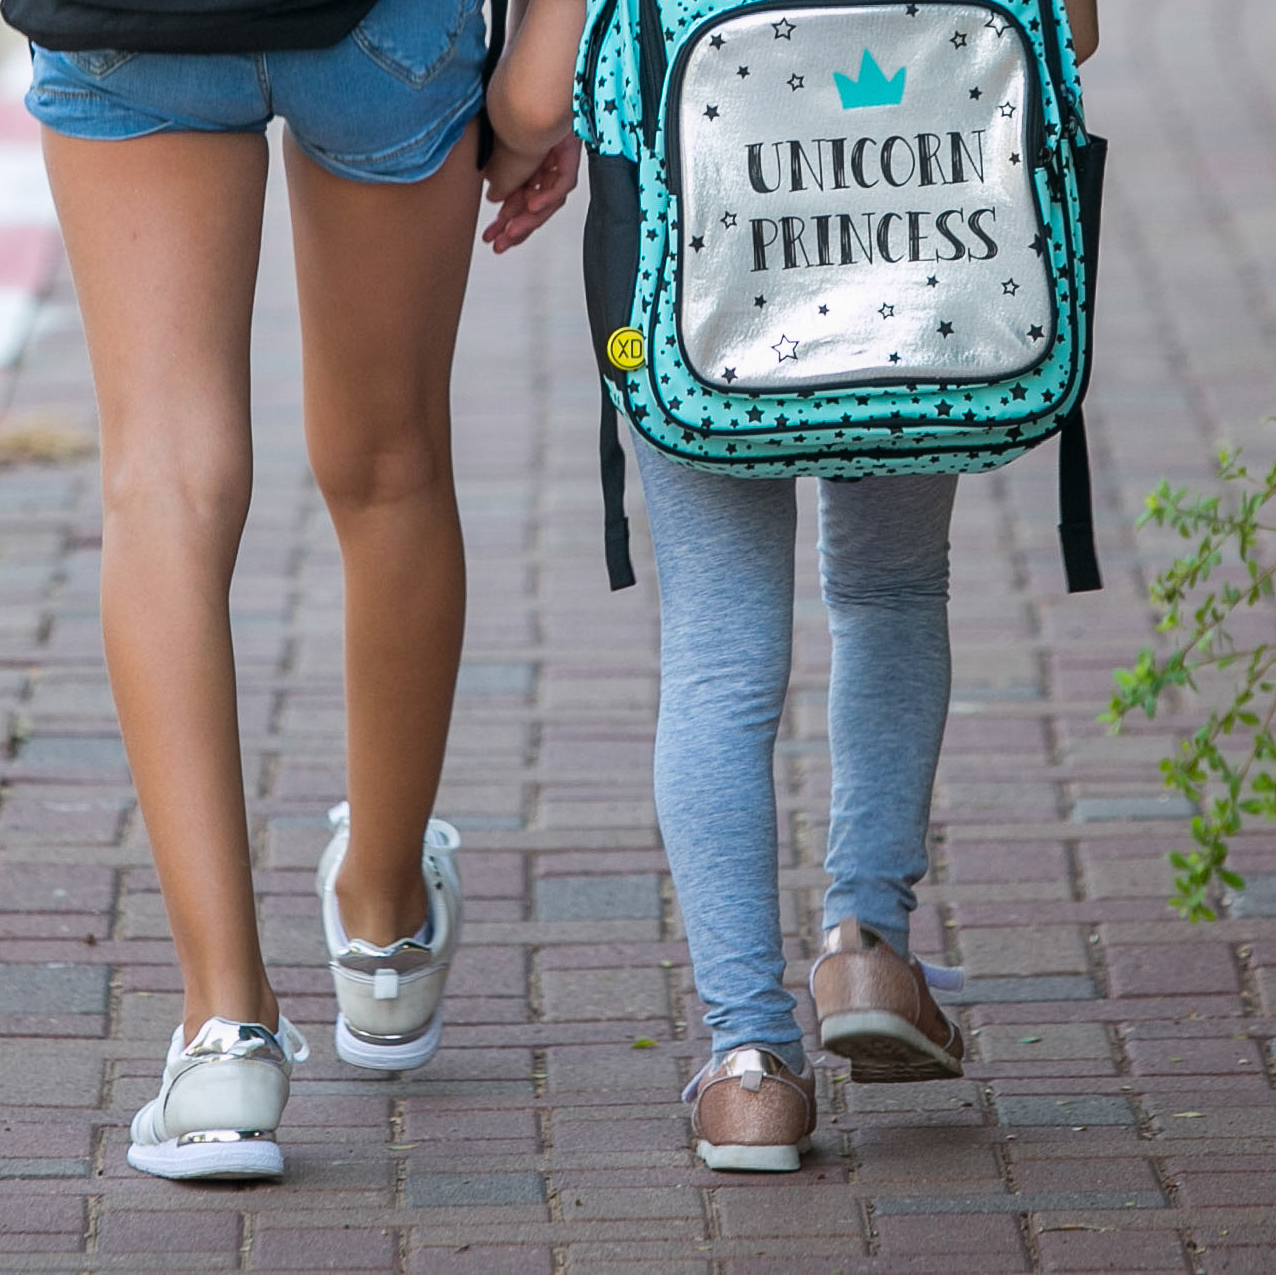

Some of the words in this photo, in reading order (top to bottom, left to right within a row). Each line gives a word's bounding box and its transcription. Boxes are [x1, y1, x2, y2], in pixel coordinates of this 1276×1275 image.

[745, 129, 986, 194] UNICORN
[749, 206, 998, 272] PRINCESS
[617, 338, 643, 359] XD
